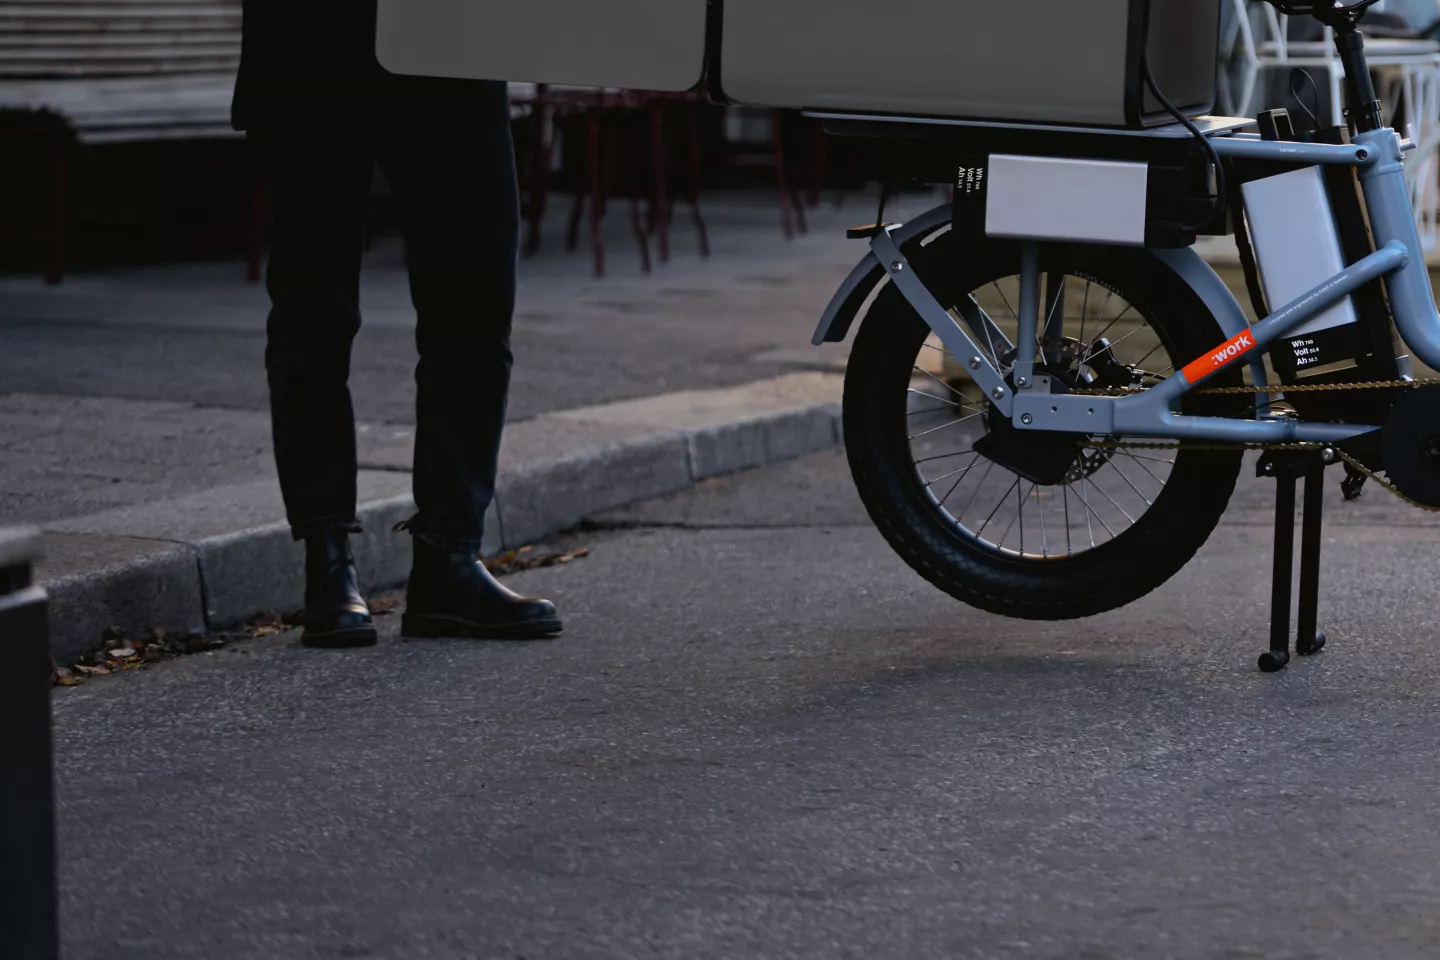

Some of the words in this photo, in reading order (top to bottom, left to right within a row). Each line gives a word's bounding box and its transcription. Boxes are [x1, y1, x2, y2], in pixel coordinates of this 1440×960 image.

[958, 166, 966, 178] Ah
[966, 167, 975, 182] Volt
[976, 167, 983, 181] Wh
[1291, 340, 1305, 348] Wh
[1293, 347, 1309, 357] Volt
[1297, 357, 1308, 366] Ah
